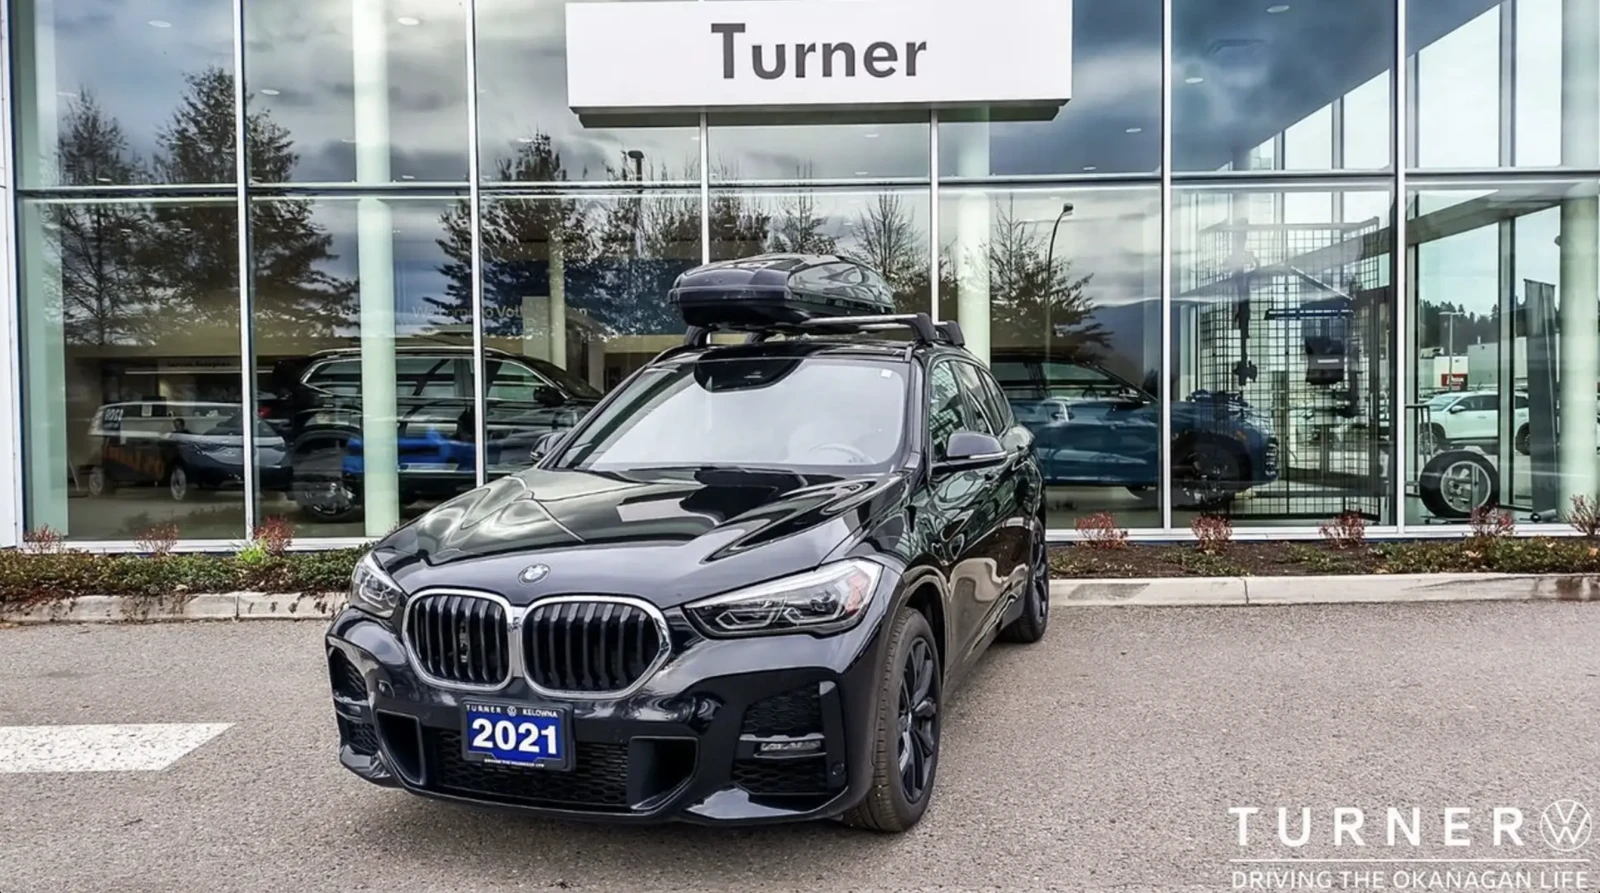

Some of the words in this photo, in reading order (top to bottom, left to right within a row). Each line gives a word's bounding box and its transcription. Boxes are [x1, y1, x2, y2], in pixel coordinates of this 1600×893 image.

[711, 23, 927, 80] Turner
[466, 704, 502, 714] TURNER
[523, 708, 558, 718] KELOWNA
[472, 718, 557, 754] 2021
